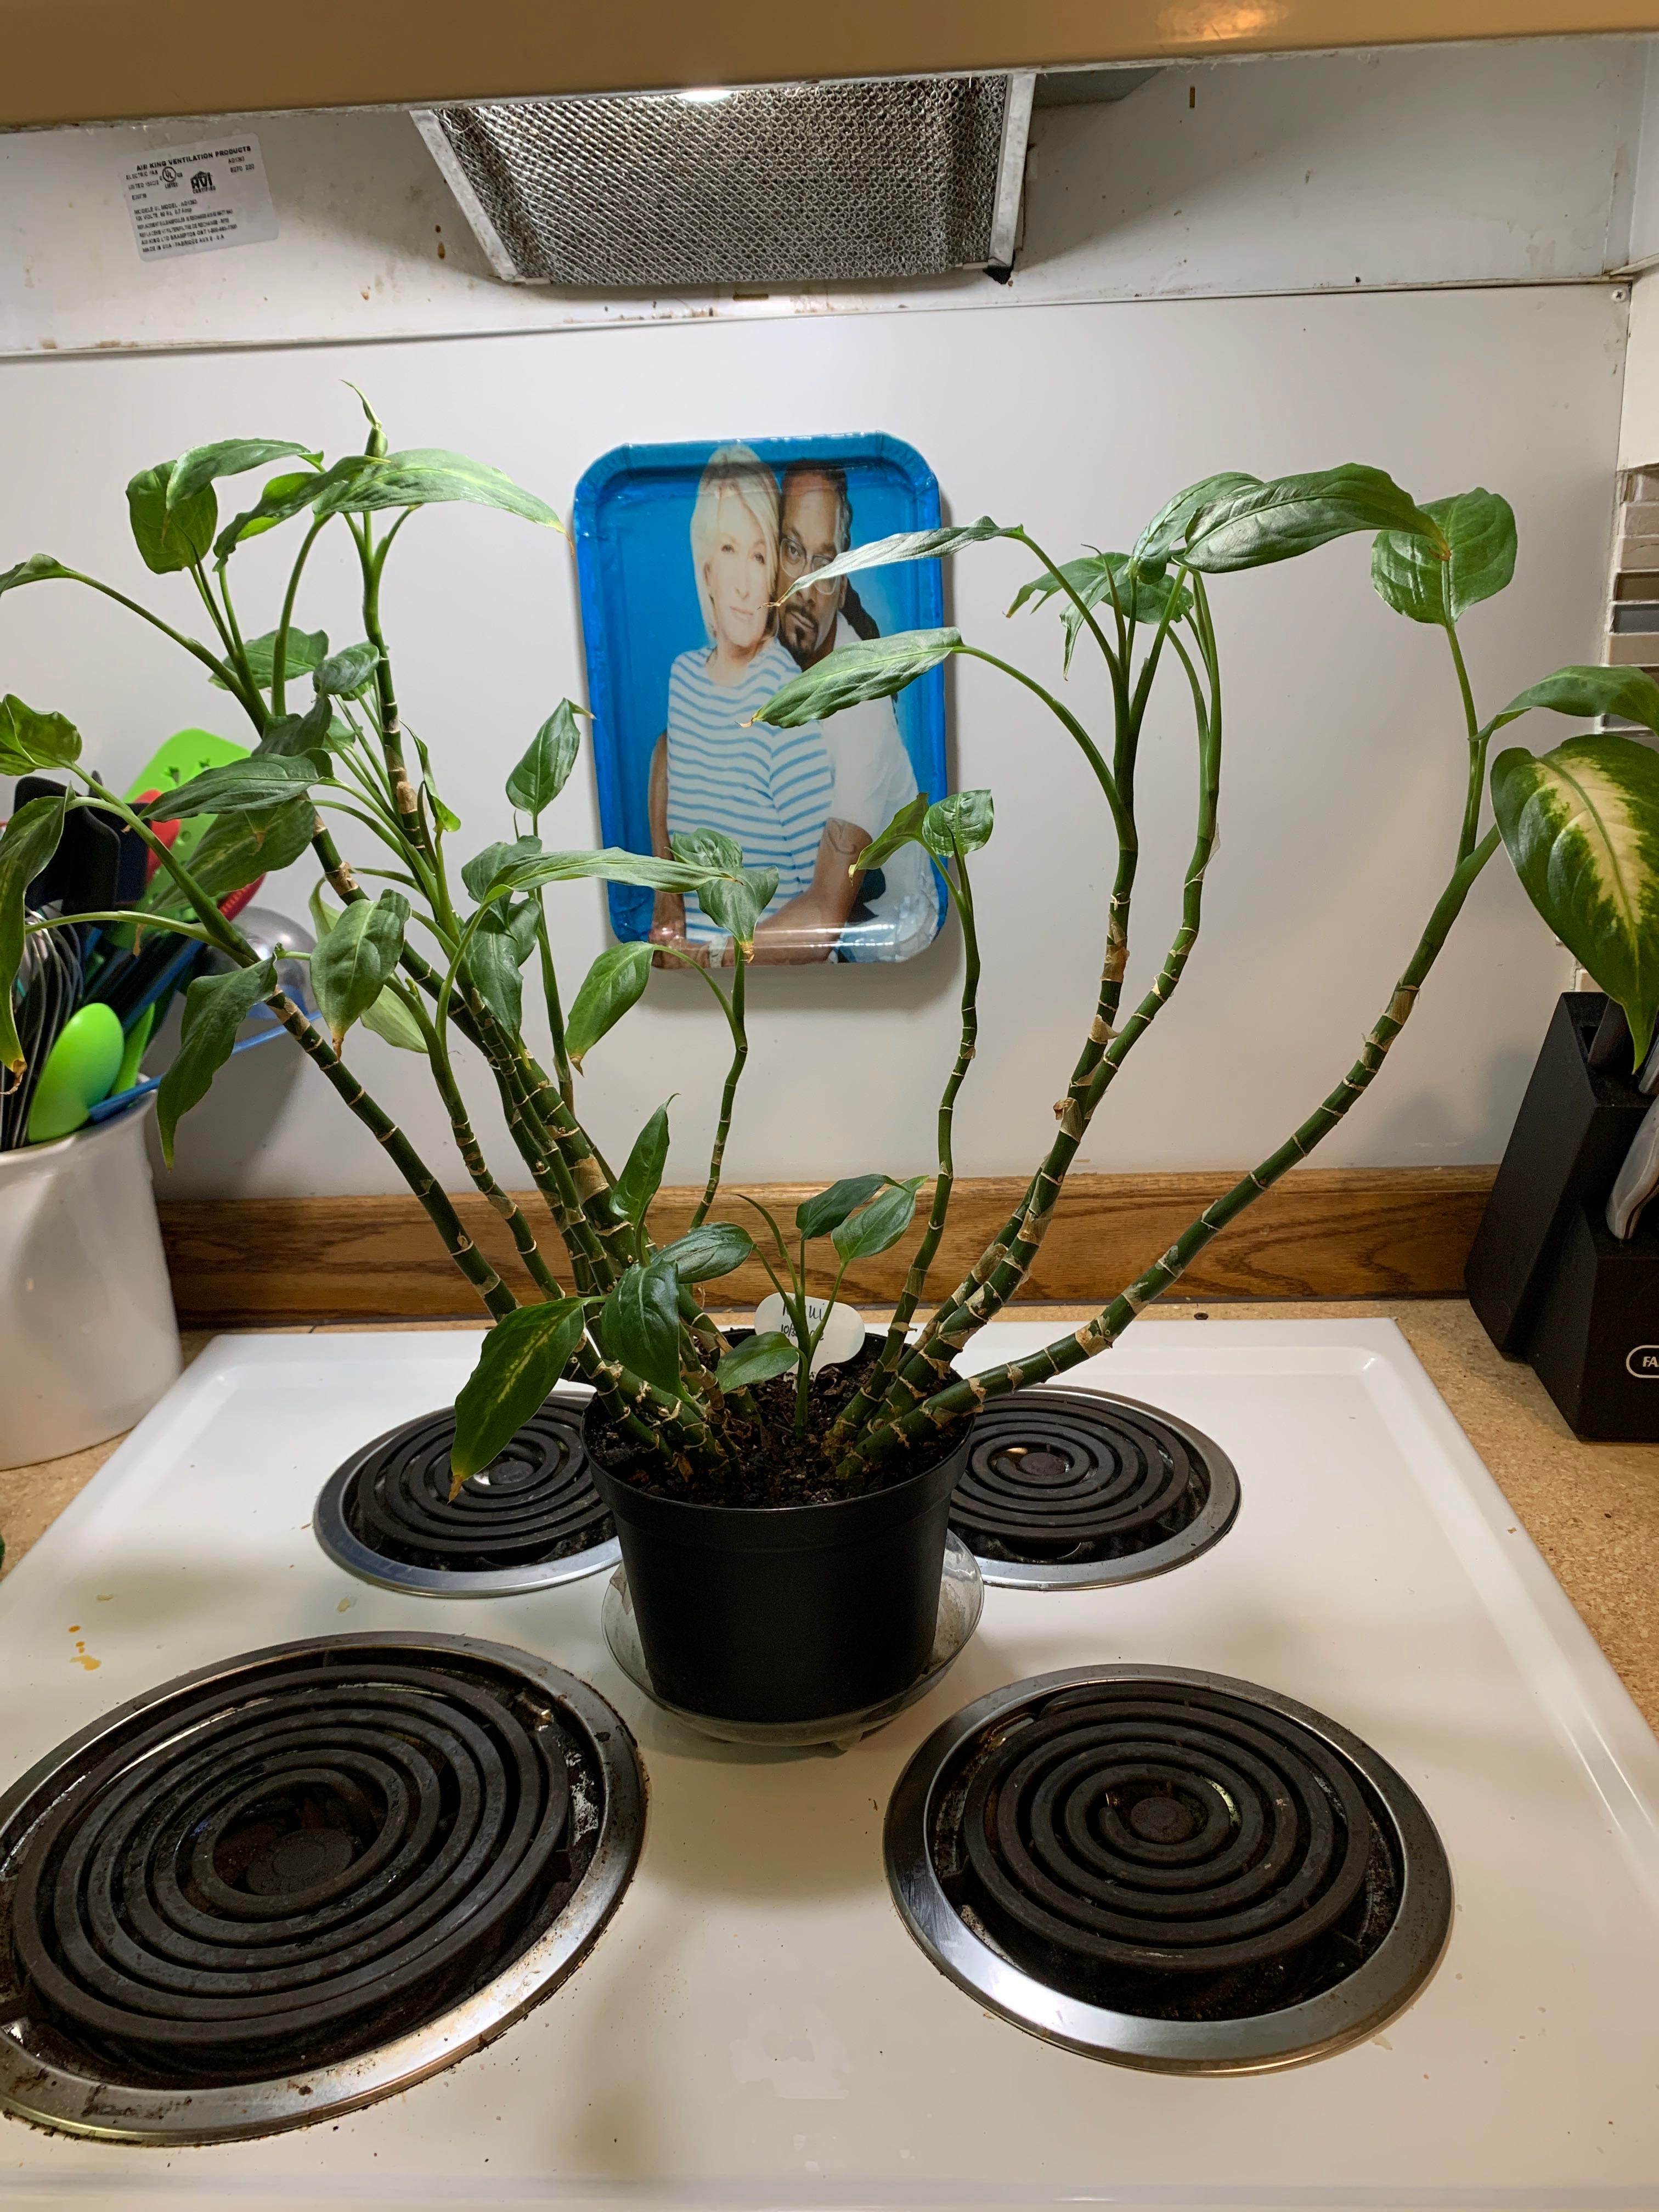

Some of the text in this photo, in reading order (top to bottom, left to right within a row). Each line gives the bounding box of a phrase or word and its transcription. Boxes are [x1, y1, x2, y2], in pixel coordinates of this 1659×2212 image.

[168, 153, 213, 165] VENTILATION
[215, 145, 251, 157] PRODUCTS
[1642, 1356, 1659, 1368] FA
